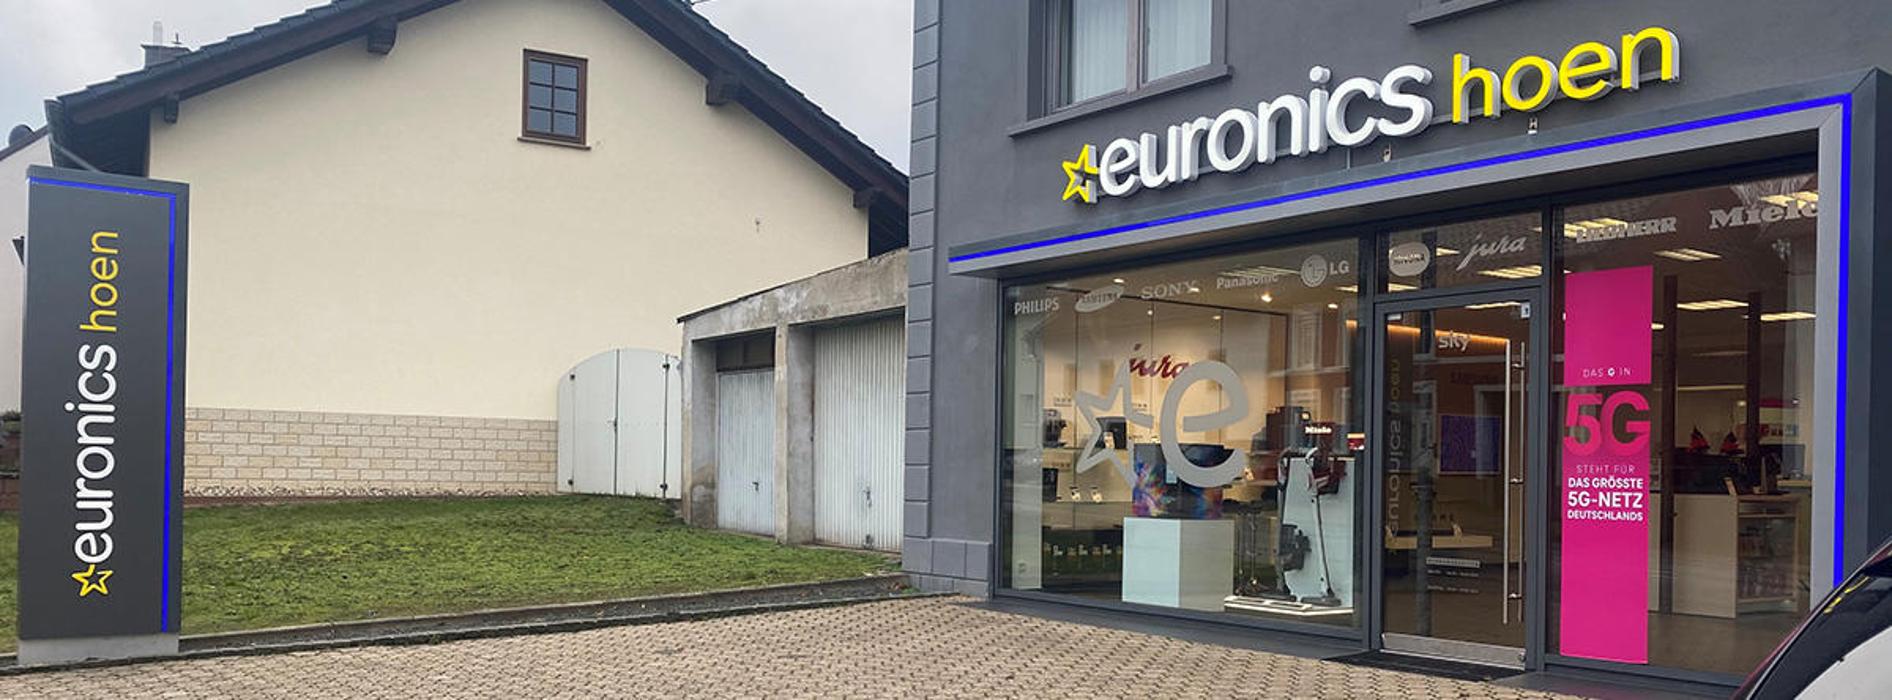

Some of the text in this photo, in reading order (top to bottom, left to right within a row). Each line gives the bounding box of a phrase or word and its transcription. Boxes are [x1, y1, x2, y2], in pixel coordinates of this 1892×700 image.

[1099, 26, 1680, 196] euronics hoen
[1456, 233, 1527, 271] jura
[1328, 259, 1350, 275] LG
[1140, 279, 1197, 300] SONY
[1216, 273, 1280, 289] Panasonic
[1013, 296, 1060, 316] PHILIPS
[1582, 368, 1604, 378] DAS
[1618, 367, 1632, 377] IN
[65, 231, 119, 563] euronics hoen
[1563, 390, 1651, 456] 5G
[1576, 464, 1610, 474] STEHT
[1568, 475, 1644, 489] DAS GRÖSSTE
[1568, 491, 1644, 508] 5G-NETZ
[1567, 509, 1644, 521] DEUTSCHLANDS
